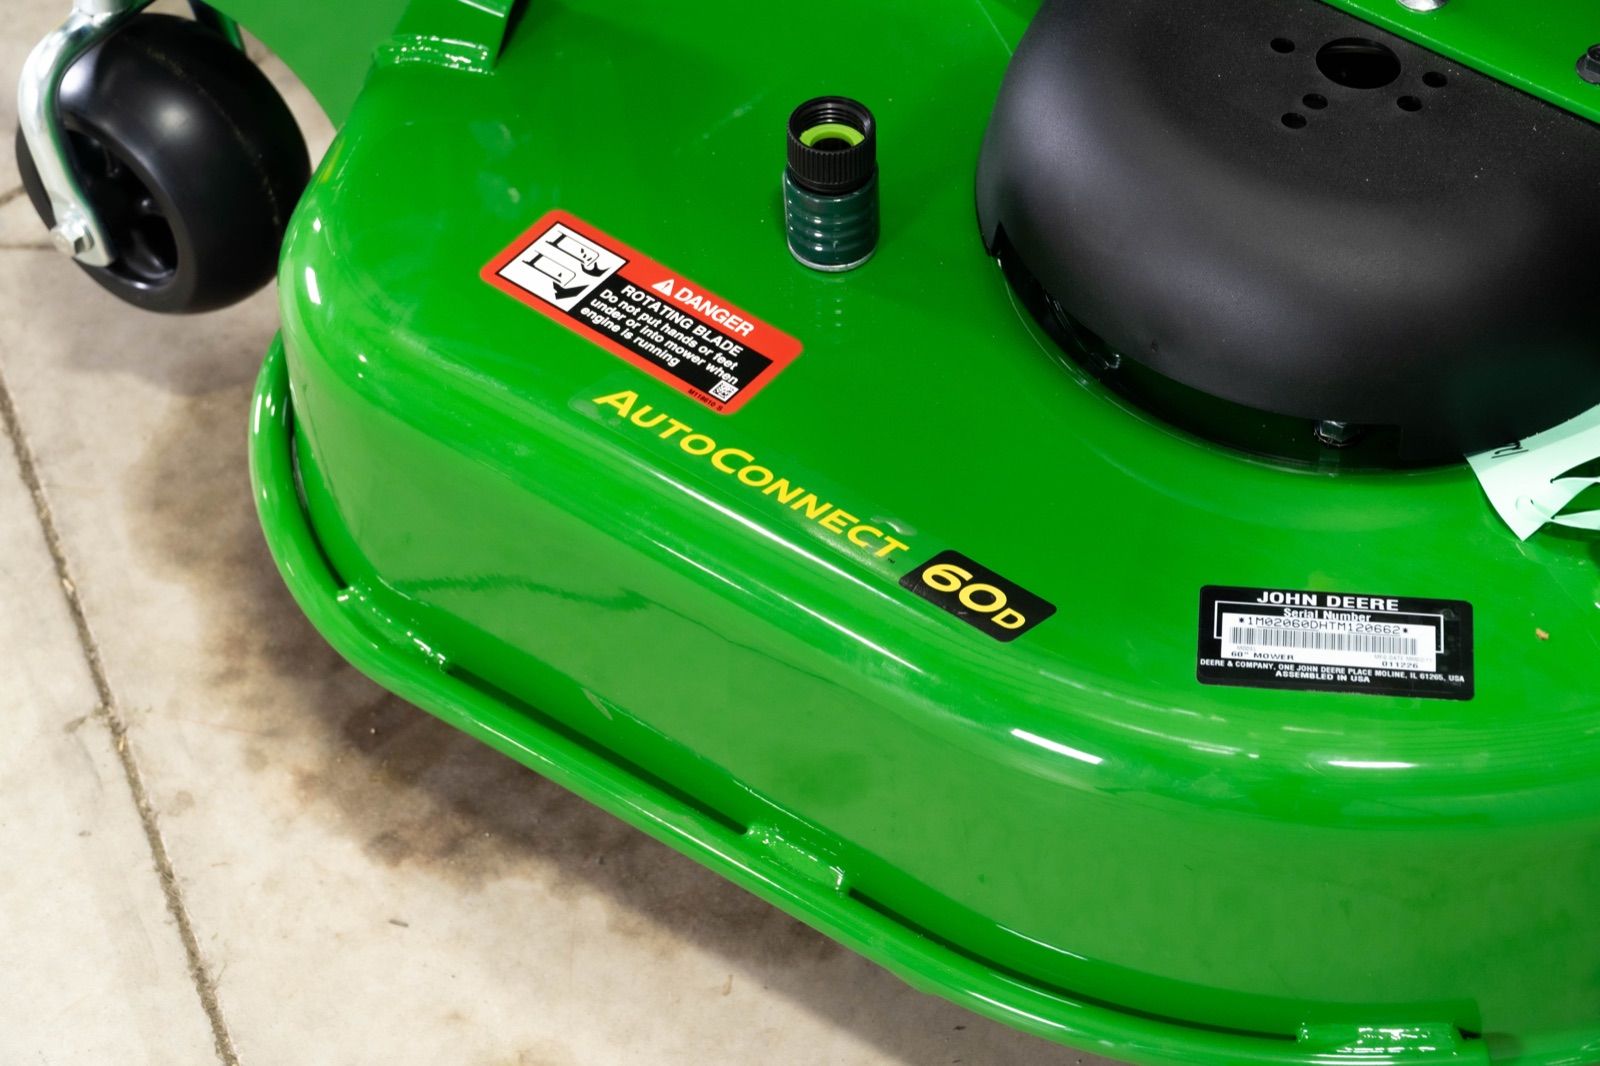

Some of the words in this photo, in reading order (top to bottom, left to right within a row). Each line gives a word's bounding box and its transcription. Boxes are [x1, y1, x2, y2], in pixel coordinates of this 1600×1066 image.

[600, 289, 618, 304] Do
[618, 299, 642, 316] not
[638, 311, 663, 331] put
[660, 321, 698, 349] hands
[698, 343, 715, 357] or
[712, 349, 739, 371] feet
[621, 284, 694, 329] ROTATING
[692, 322, 743, 357] BLADE
[674, 287, 754, 337] DANGER
[580, 306, 621, 333] engine
[621, 326, 634, 340] is
[633, 335, 681, 368] running
[590, 298, 626, 321] under
[625, 317, 642, 330] or
[639, 325, 664, 344] into
[664, 338, 707, 366] mower
[706, 361, 739, 385] when
[1257, 591, 1317, 606] JOHN
[1327, 595, 1399, 611] DEERE
[1283, 608, 1319, 619] Serial
[1323, 610, 1371, 622] Number
[1200, 658, 1225, 667] DEERE
[1227, 660, 1233, 668] &
[1235, 660, 1277, 671] COMPANY,
[1278, 663, 1295, 671] ONE
[1297, 664, 1318, 673] JOHN
[1320, 665, 1345, 674] DEERE
[1347, 667, 1373, 677] PLACE
[1410, 671, 1418, 679] IL
[1448, 674, 1465, 683] USA
[1253, 652, 1294, 661] MOWER
[1275, 670, 1334, 681] ASSEMBLED
[1337, 673, 1348, 682] IN
[1350, 674, 1371, 683] USA
